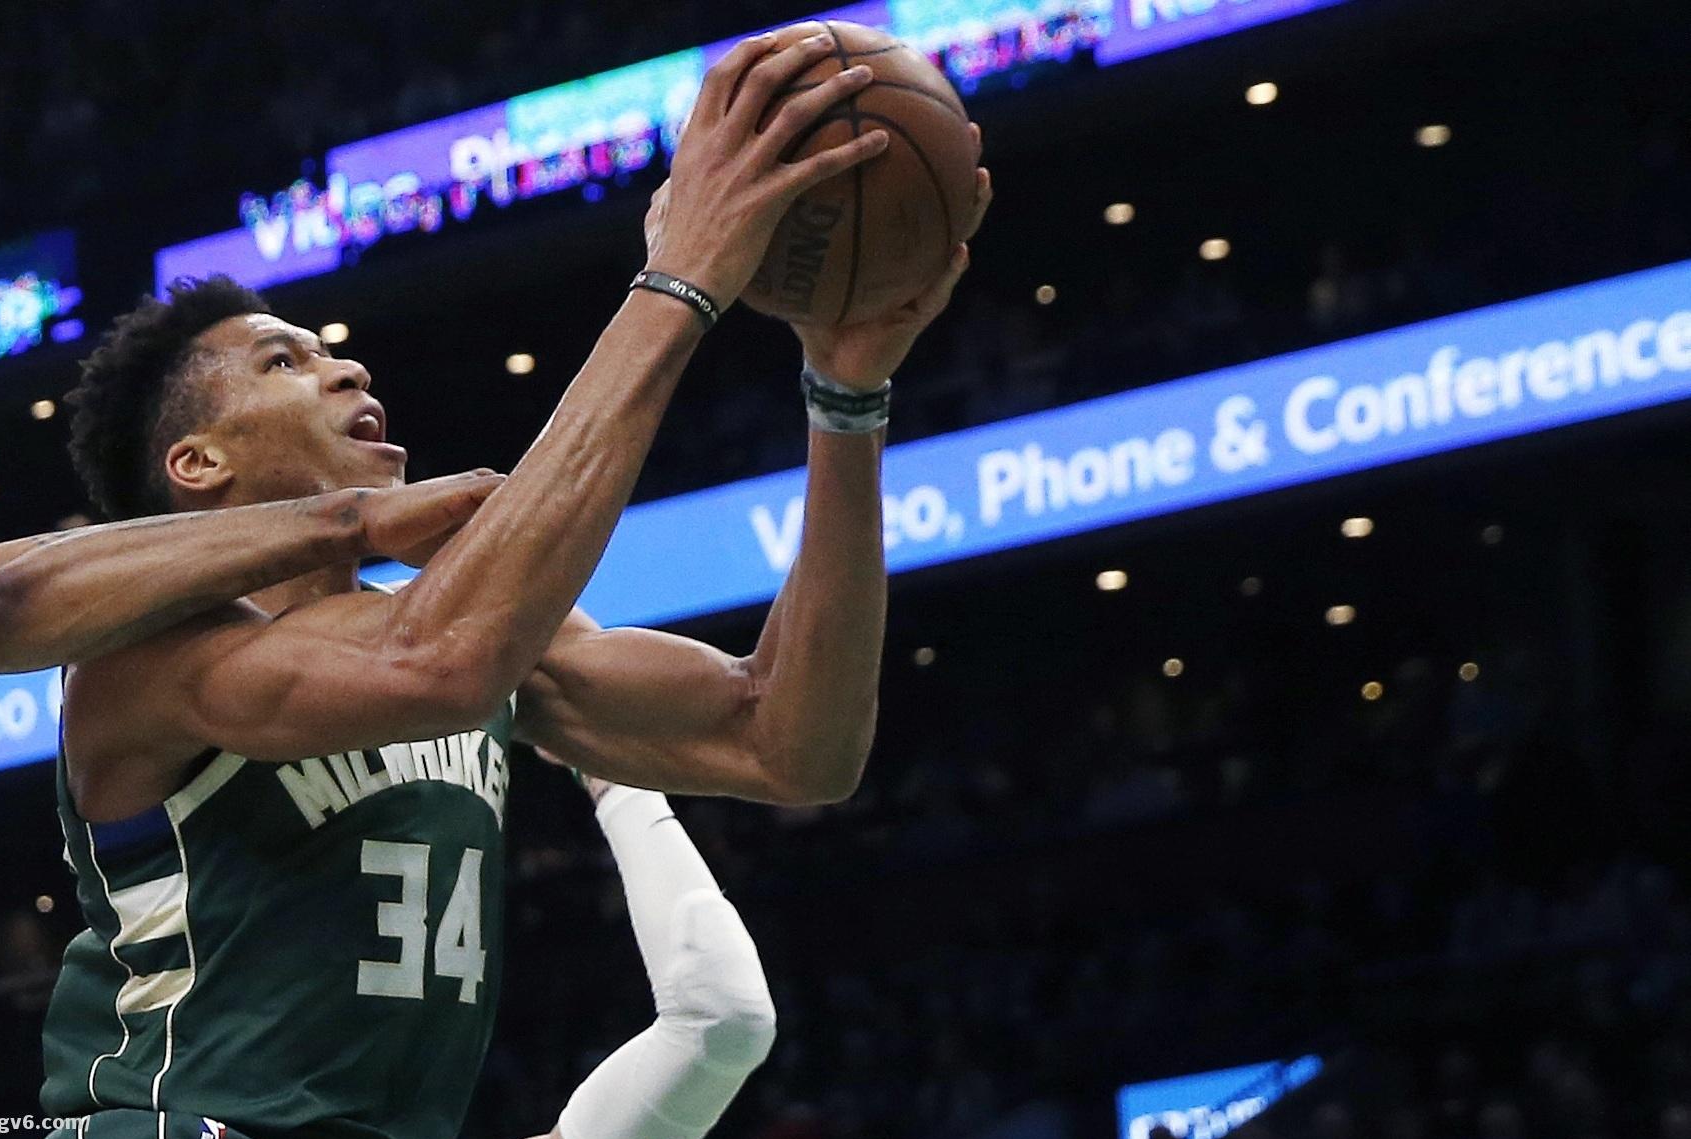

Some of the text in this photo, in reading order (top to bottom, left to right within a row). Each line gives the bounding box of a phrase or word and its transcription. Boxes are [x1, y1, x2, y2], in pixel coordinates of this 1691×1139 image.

[669, 280, 687, 295] Up
[750, 310, 1691, 572] Veo, Phone & Conference
[357, 839, 486, 1004] 34
